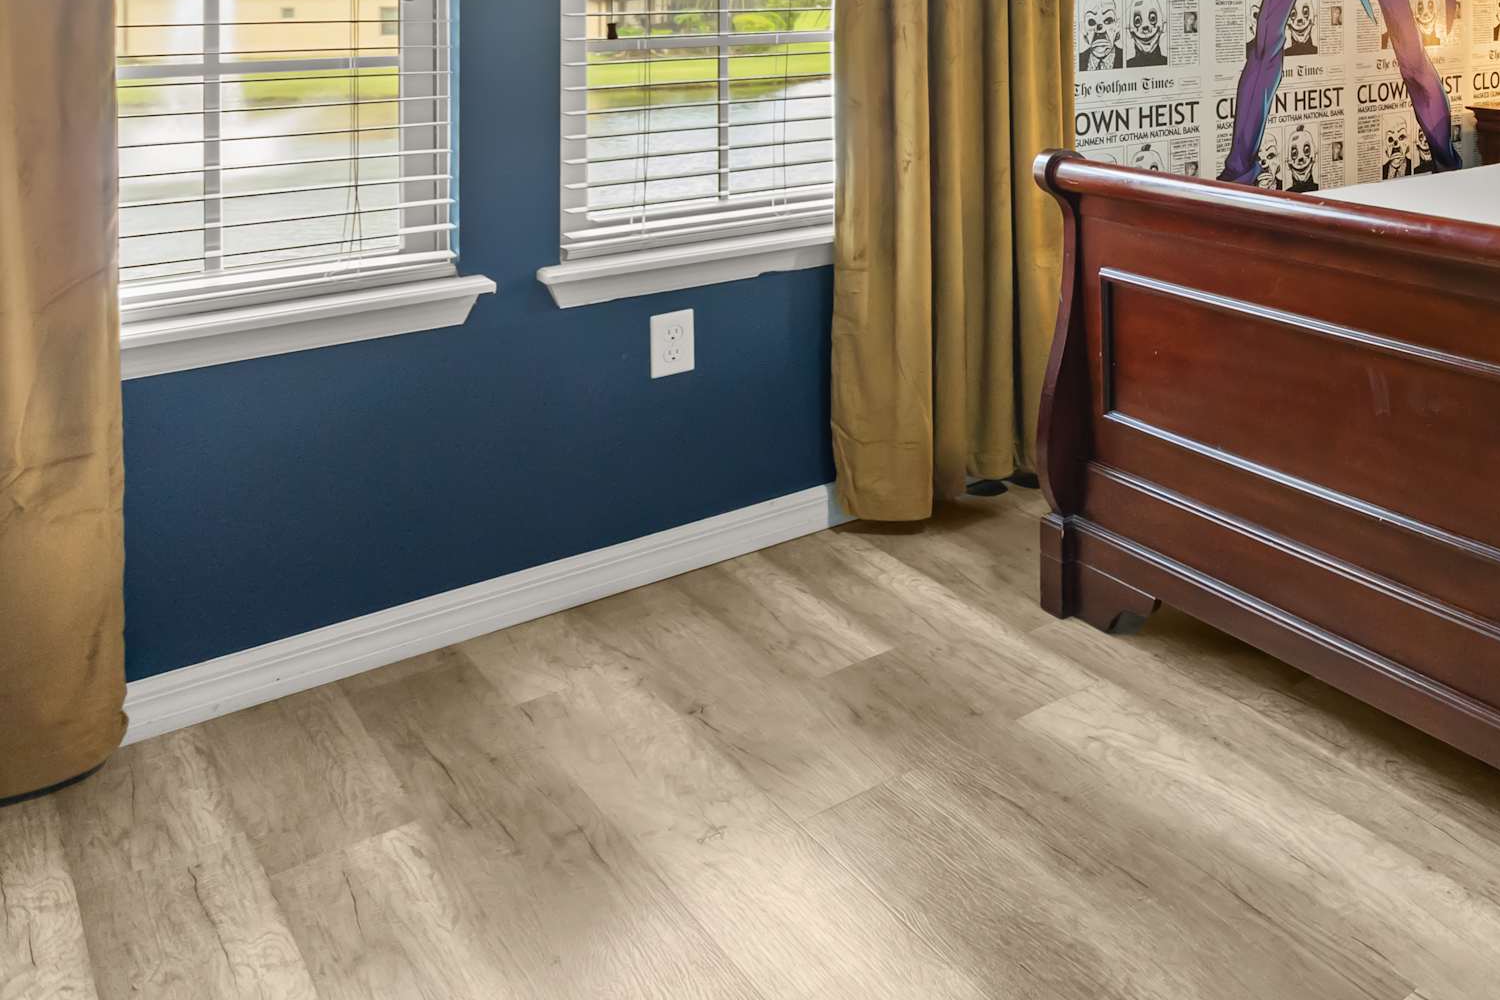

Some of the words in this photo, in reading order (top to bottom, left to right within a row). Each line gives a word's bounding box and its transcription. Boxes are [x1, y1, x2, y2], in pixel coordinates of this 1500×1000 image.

[1298, 65, 1324, 77] Times
[1096, 80, 1137, 96] Gotham
[1142, 77, 1175, 91] Times
[1295, 87, 1344, 112] HEIST
[1076, 108, 1130, 136] OWN
[1139, 102, 1200, 129] HEIST
[1216, 121, 1232, 130] MASK
[1278, 113, 1302, 124] GOTHAM
[1303, 111, 1329, 120] NATIONAL
[1331, 109, 1344, 118] BANK
[1106, 135, 1117, 145] HIT
[1120, 131, 1149, 142] GOTHAM
[1150, 128, 1182, 139] NATIONAL
[1182, 126, 1200, 136] BANK
